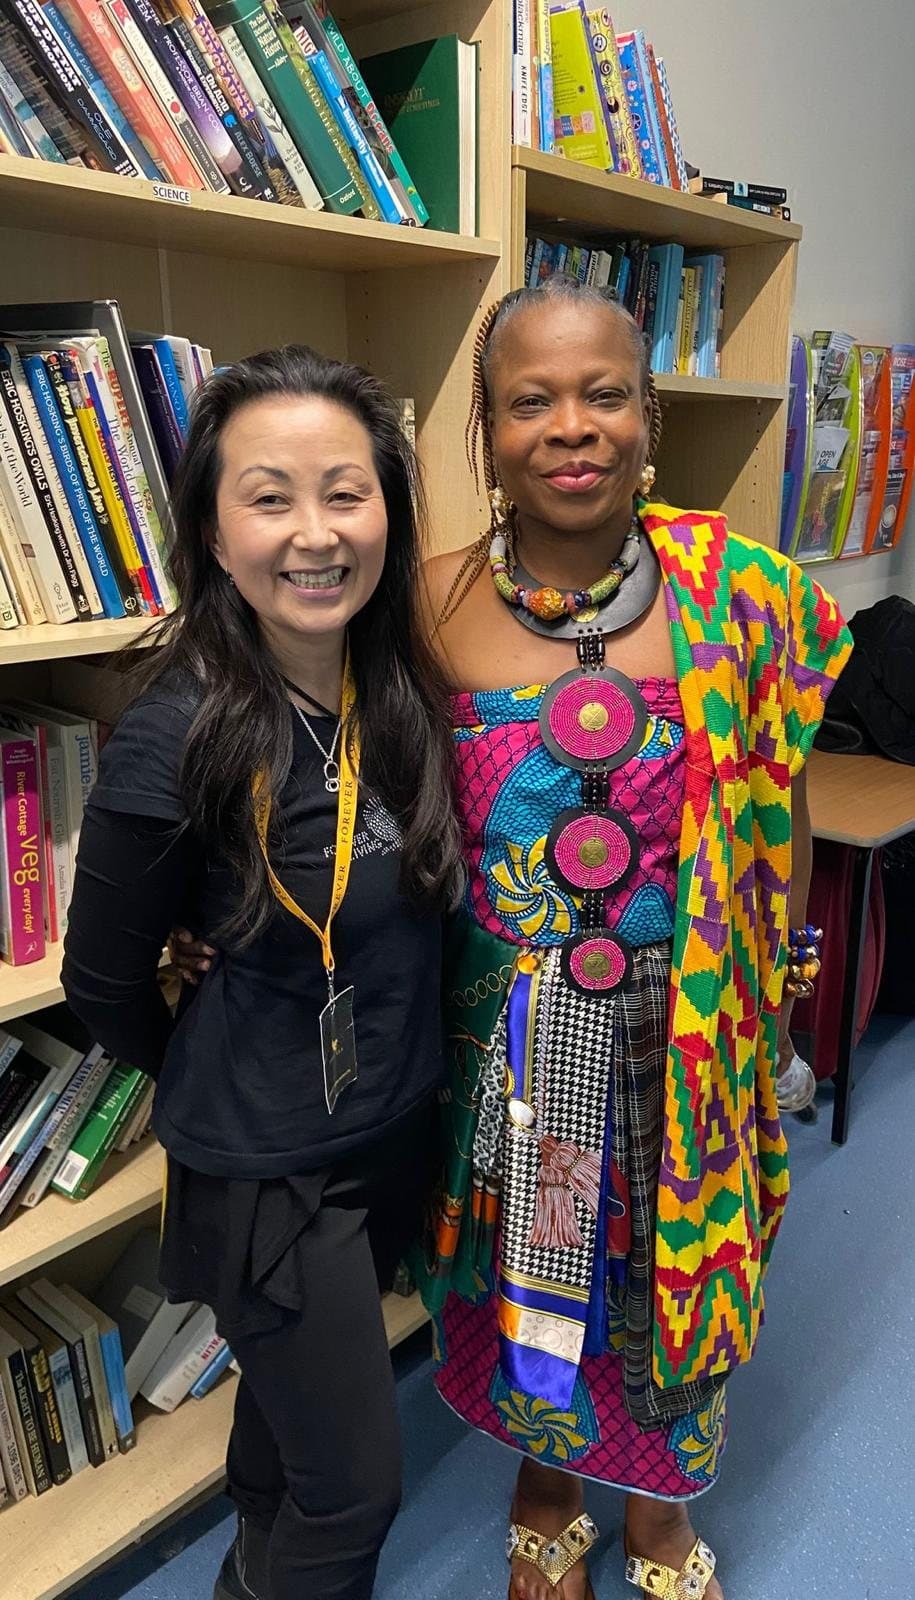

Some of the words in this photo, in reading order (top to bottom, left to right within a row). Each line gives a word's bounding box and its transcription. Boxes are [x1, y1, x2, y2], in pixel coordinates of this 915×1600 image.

[47, 6, 66, 31] River
[61, 29, 77, 48] Out
[72, 46, 83, 58] of
[78, 56, 97, 80] Eden
[294, 27, 316, 55] NIG
[38, 38, 75, 93] MOTION
[40, 26, 82, 87] D'ETAT
[177, 22, 210, 74] ELEPHANTS
[212, 87, 230, 112] ACID
[191, 22, 251, 119] DINOSAURS
[325, 21, 345, 53] WILD
[340, 54, 368, 100] ABOUT
[162, 34, 194, 84] PROFESSOR
[190, 84, 210, 112] BRIAN
[206, 112, 222, 133] COX
[302, 77, 321, 107] WILD
[318, 110, 335, 135] LIFE
[92, 110, 113, 140] OLE
[233, 130, 249, 152] ALEX
[243, 151, 263, 178] BOESE
[153, 186, 190, 202] SCIENCE
[100, 347, 112, 367] The
[0, 368, 17, 398] ERIC
[33, 366, 48, 390] ERIC
[54, 382, 75, 417] How
[105, 367, 133, 429] RUPERT
[9, 397, 37, 456] HOSKING'S
[41, 389, 66, 444] HOSKING'S
[106, 414, 124, 442] The
[0, 438, 14, 455] of
[59, 443, 75, 473] BIRDS
[64, 416, 99, 488] Invertebrates
[123, 430, 141, 466] Annual
[820, 450, 836, 459] OPEN
[5, 452, 23, 473] the
[29, 455, 48, 490] OWLS
[114, 444, 137, 481] World
[10, 470, 34, 507] World
[68, 473, 80, 487] OF
[106, 464, 117, 483] BEST
[112, 484, 123, 502] BITS
[127, 483, 142, 498] of
[42, 493, 53, 507] Eric
[73, 486, 88, 511] PREY
[88, 486, 106, 514] Live
[131, 498, 151, 529] Beer
[45, 506, 63, 534] Hosking
[80, 510, 92, 524] OF
[55, 532, 67, 549] with
[85, 524, 99, 545] THE
[63, 556, 74, 569] Jim
[91, 544, 109, 578] WORLD
[66, 568, 81, 587] Flegg
[74, 734, 94, 785] jamie
[15, 770, 26, 796] River
[14, 797, 29, 836] Cottage
[342, 780, 353, 844] FOREVER
[11, 834, 40, 885] veg
[323, 831, 370, 859] FOVER
[351, 838, 383, 861] IVING
[20, 886, 32, 914] every
[22, 913, 34, 933] day!
[199, 1334, 222, 1361] PALIN
[14, 1370, 25, 1387] The
[16, 1386, 31, 1416] RIGHT
[23, 1415, 35, 1431] TO
[26, 1429, 38, 1444] BE
[29, 1442, 47, 1478] HUMAN
